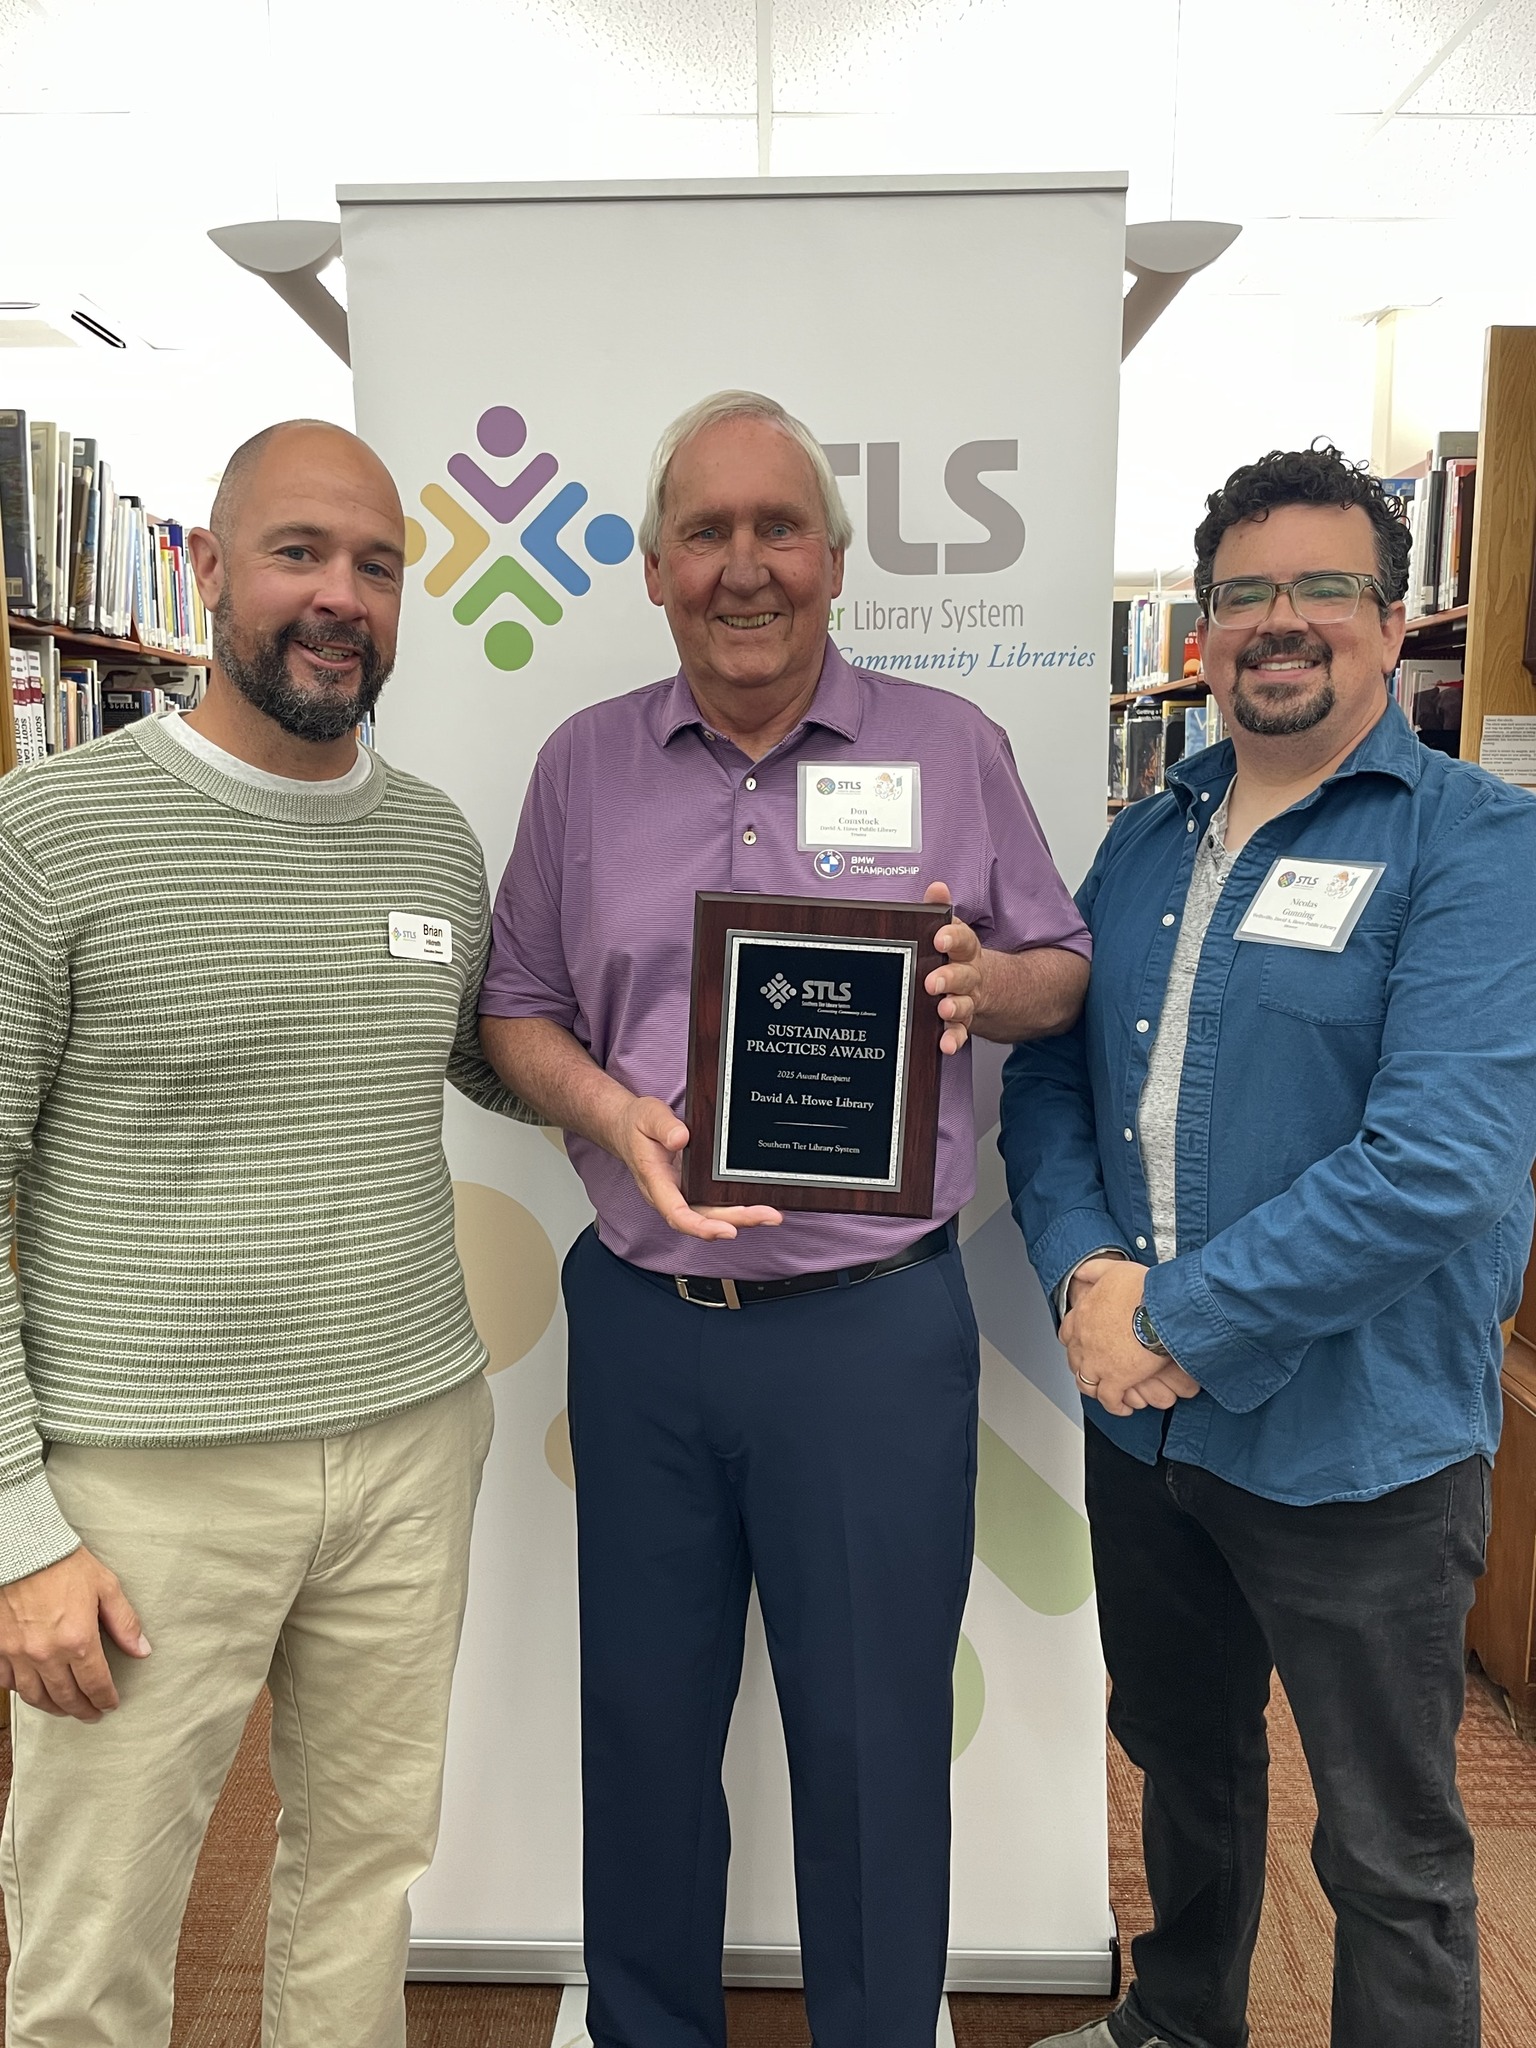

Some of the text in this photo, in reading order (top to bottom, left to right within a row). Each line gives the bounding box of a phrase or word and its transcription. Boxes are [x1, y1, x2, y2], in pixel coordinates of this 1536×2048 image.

[821, 439, 1026, 575] LS
[827, 599, 1024, 634] er Library System
[987, 642, 1096, 668] Libraries
[20, 718, 30, 746] SCOTT
[35, 715, 44, 744] SCOTT
[838, 781, 861, 790] STLS
[850, 807, 868, 815] Don
[838, 817, 880, 825] Comstock
[851, 856, 875, 864] BMW
[850, 865, 920, 876] CHAMPIONSHIP
[1296, 876, 1319, 885] STLS
[1290, 898, 1318, 908] Nicolas
[1282, 908, 1316, 921] Gunning
[423, 923, 443, 938] Brian
[801, 980, 852, 1001] STLS
[767, 1024, 867, 1042] SUSTAINABLE
[746, 1039, 886, 1060] PRACTICES AWARD
[777, 1070, 851, 1083] 2025 Award Recipient
[750, 1091, 875, 1111] David A. Howe Library
[758, 1140, 860, 1154] Southern Tier Library System
